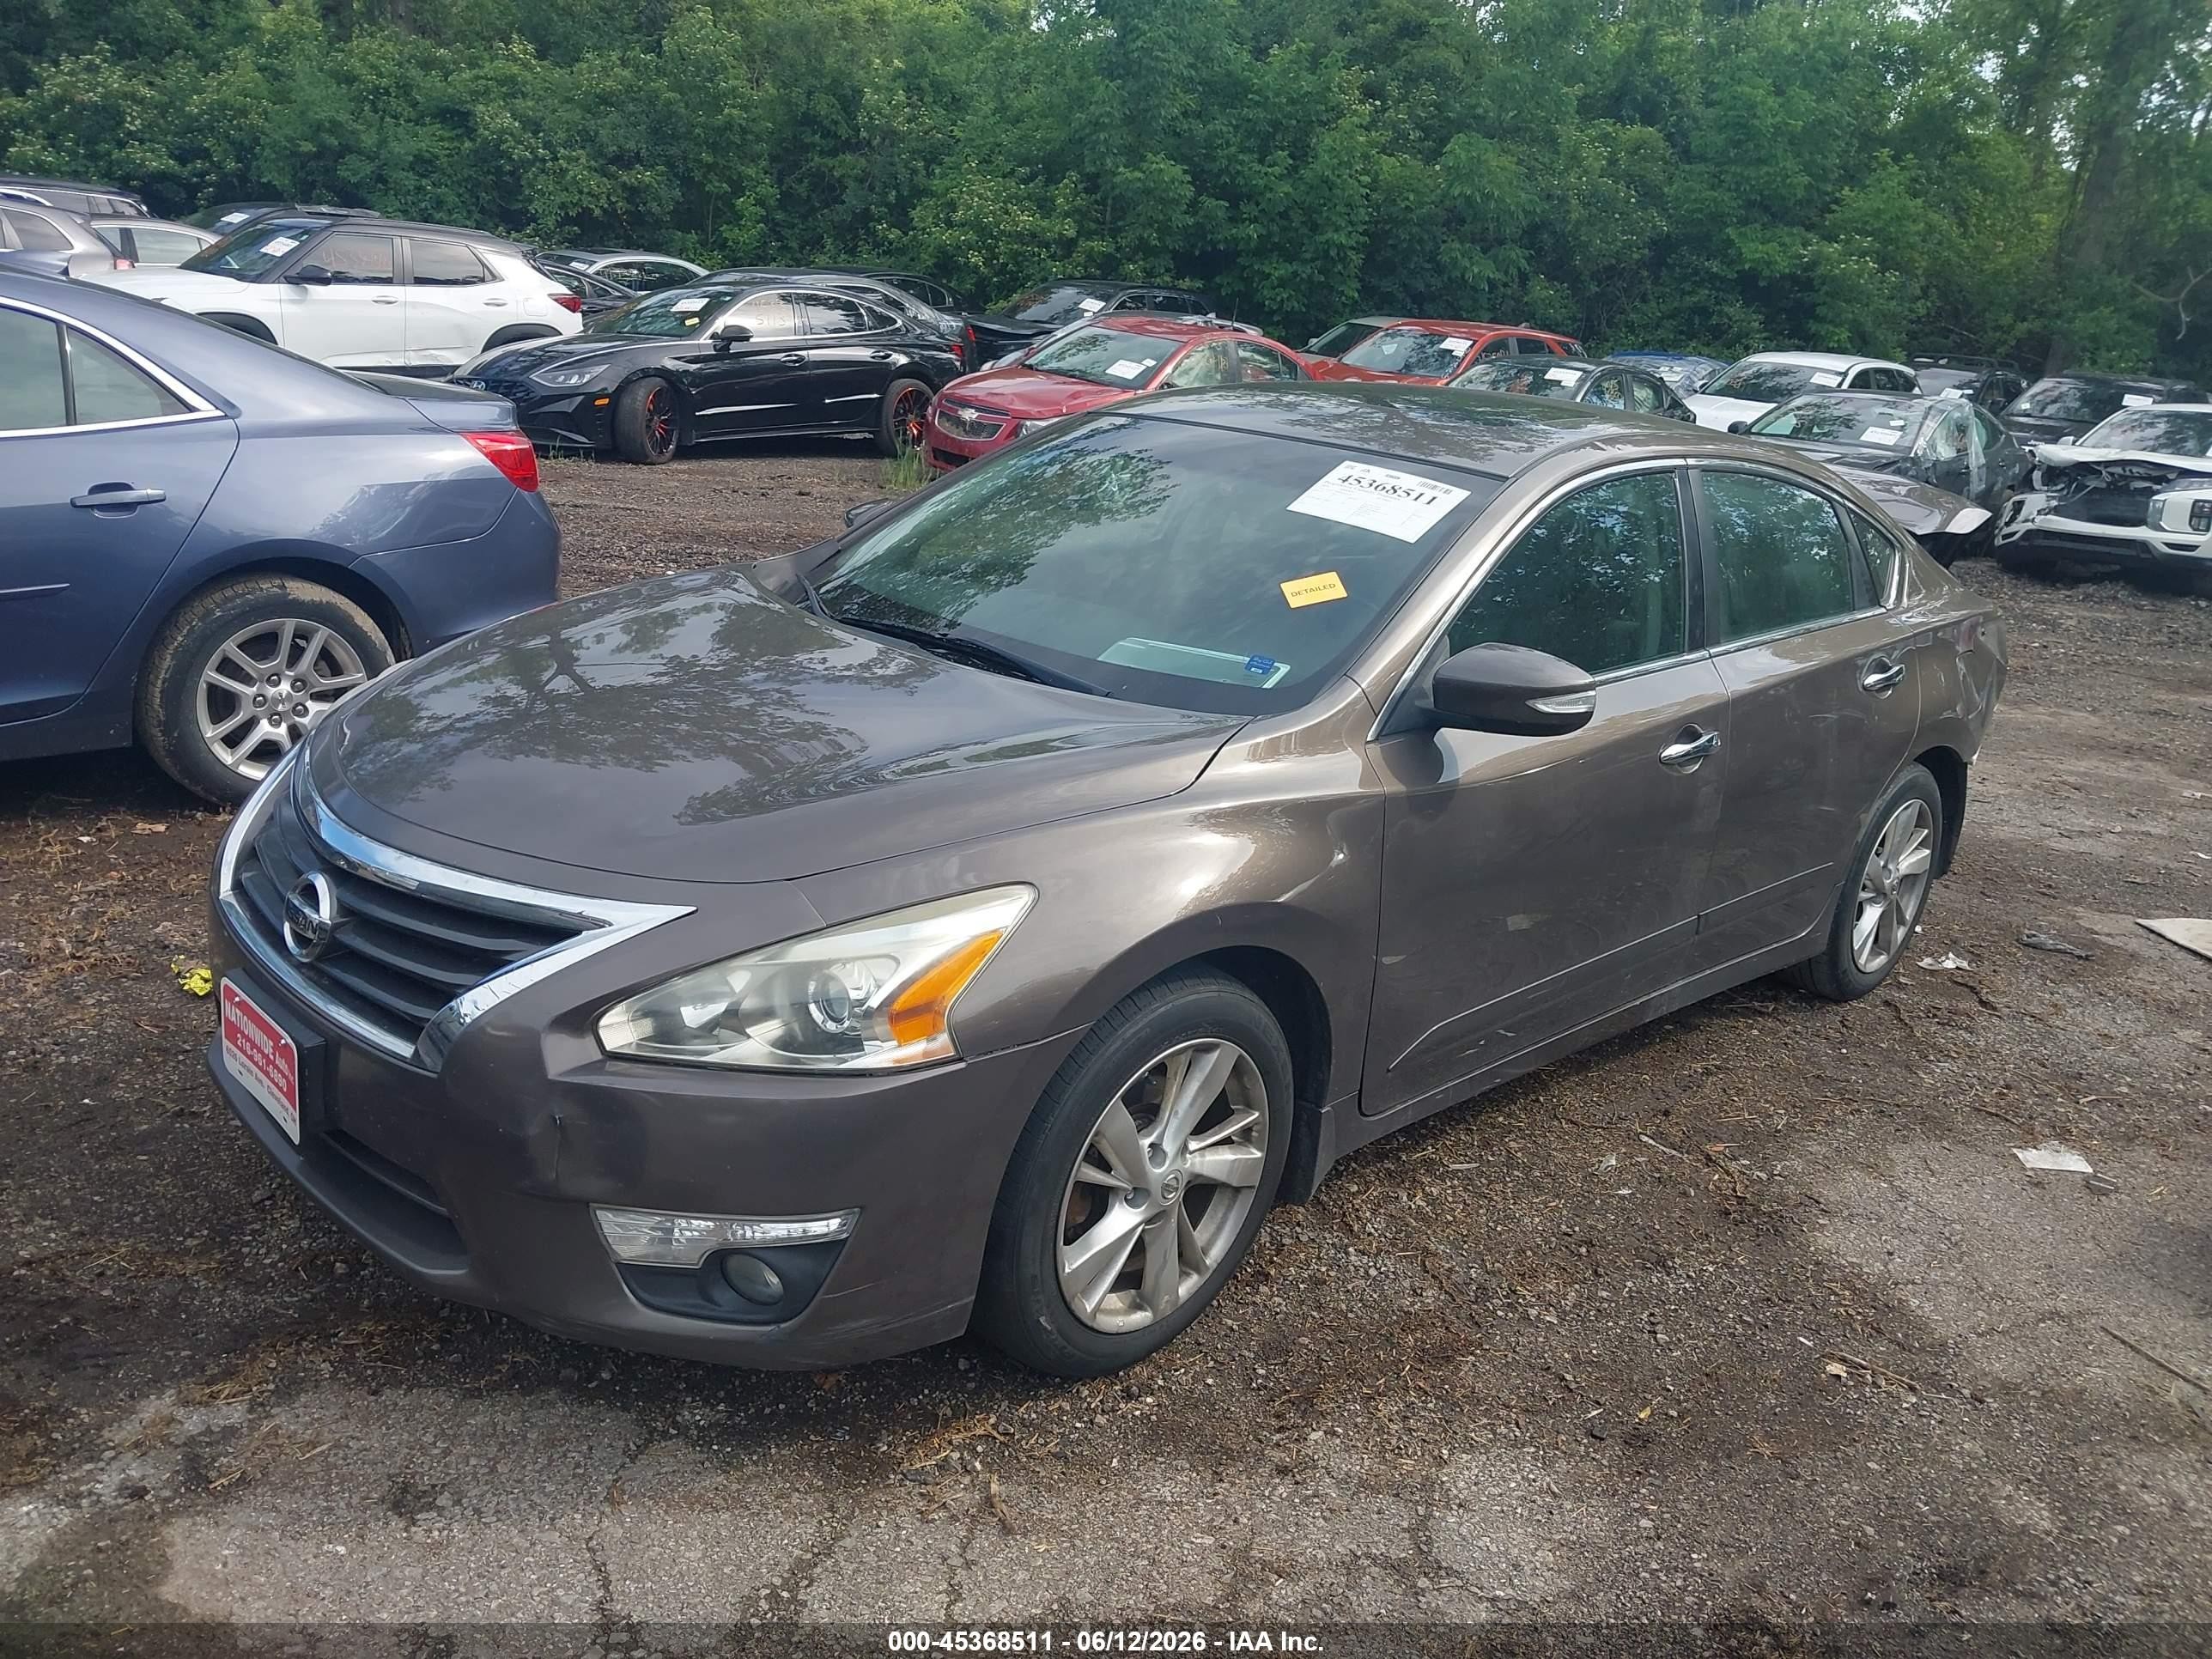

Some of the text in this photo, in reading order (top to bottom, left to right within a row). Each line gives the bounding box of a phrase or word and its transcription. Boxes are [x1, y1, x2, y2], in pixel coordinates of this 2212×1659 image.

[1337, 474, 1439, 506] 45368511
[1291, 583, 1336, 598] DETAILED
[225, 998, 275, 1061] NATIONWIDE
